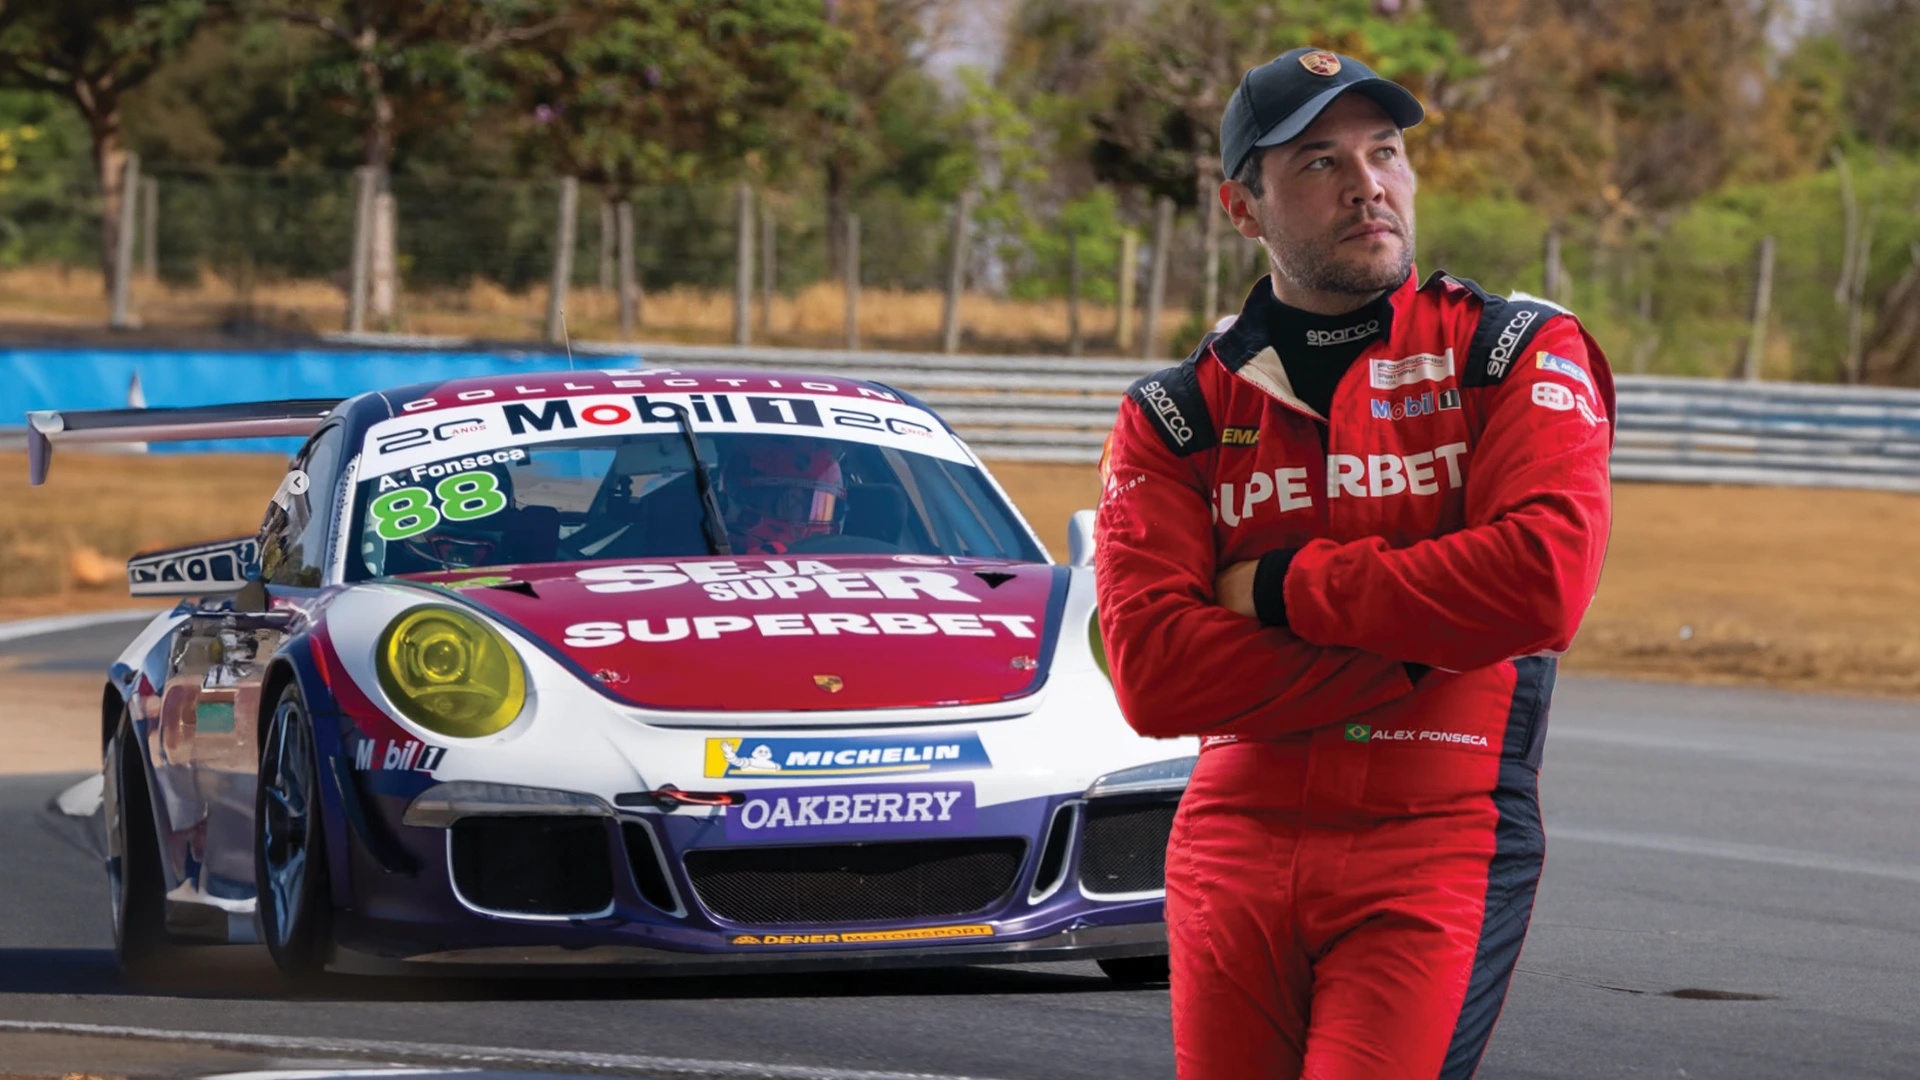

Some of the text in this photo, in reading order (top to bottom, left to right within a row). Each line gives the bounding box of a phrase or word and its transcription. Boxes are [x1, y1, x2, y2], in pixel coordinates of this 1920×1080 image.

[1306, 320, 1380, 347] sparco
[1486, 310, 1539, 379] sparco
[402, 378, 896, 412] COLLECTION
[1370, 391, 1435, 420] Mobil
[502, 394, 738, 435] Mobil
[1139, 380, 1194, 448] sparco
[410, 448, 526, 483] Fonseca
[370, 470, 507, 540] 88
[575, 560, 841, 594] SEJA
[702, 571, 982, 603] SUPER
[563, 612, 1037, 648] SUPERBET
[785, 744, 961, 767] MICHELIN
[1371, 730, 1488, 747] ALEX FONSECA
[740, 790, 962, 830] OAKBERRY
[763, 925, 988, 945] DENER MOTORSPORT
